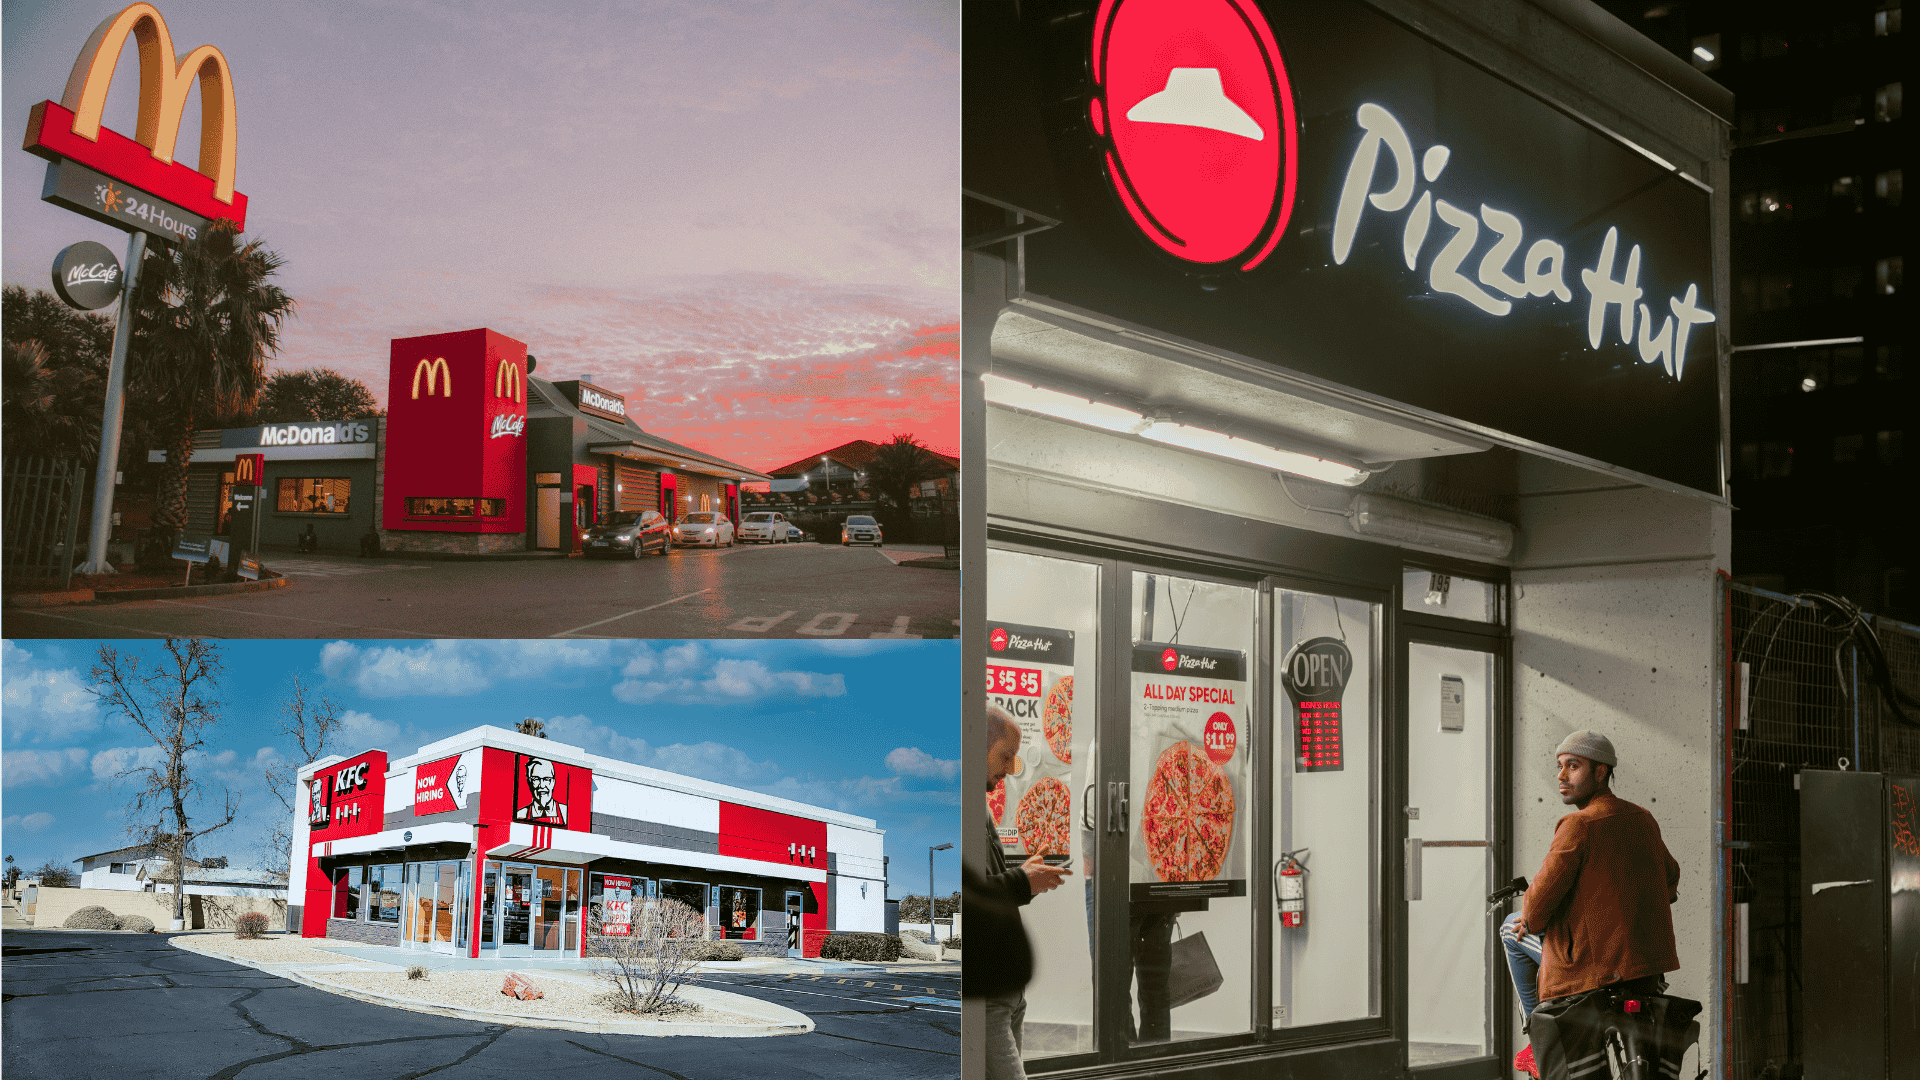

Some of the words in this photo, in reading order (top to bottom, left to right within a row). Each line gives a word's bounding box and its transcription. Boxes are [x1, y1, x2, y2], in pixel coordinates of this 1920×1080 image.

[1332, 102, 1571, 316] Pizza
[1582, 227, 1715, 381] Hut
[582, 389, 625, 416] McDonald's
[260, 423, 369, 445] McDonald's
[1432, 574, 1450, 593] 195
[1009, 635, 1033, 650] Pizza
[1179, 654, 1200, 669] Pizza
[1294, 652, 1342, 687] OPEN
[999, 669, 1017, 692] $5
[1020, 672, 1038, 694] $5
[1143, 684, 1164, 699] ALL
[1166, 685, 1187, 701] DAY
[1189, 686, 1235, 705] SPECIAL
[1213, 721, 1228, 731] ONLY
[334, 762, 368, 792] KFC
[417, 775, 437, 789] NOW
[416, 788, 444, 803] HIRING
